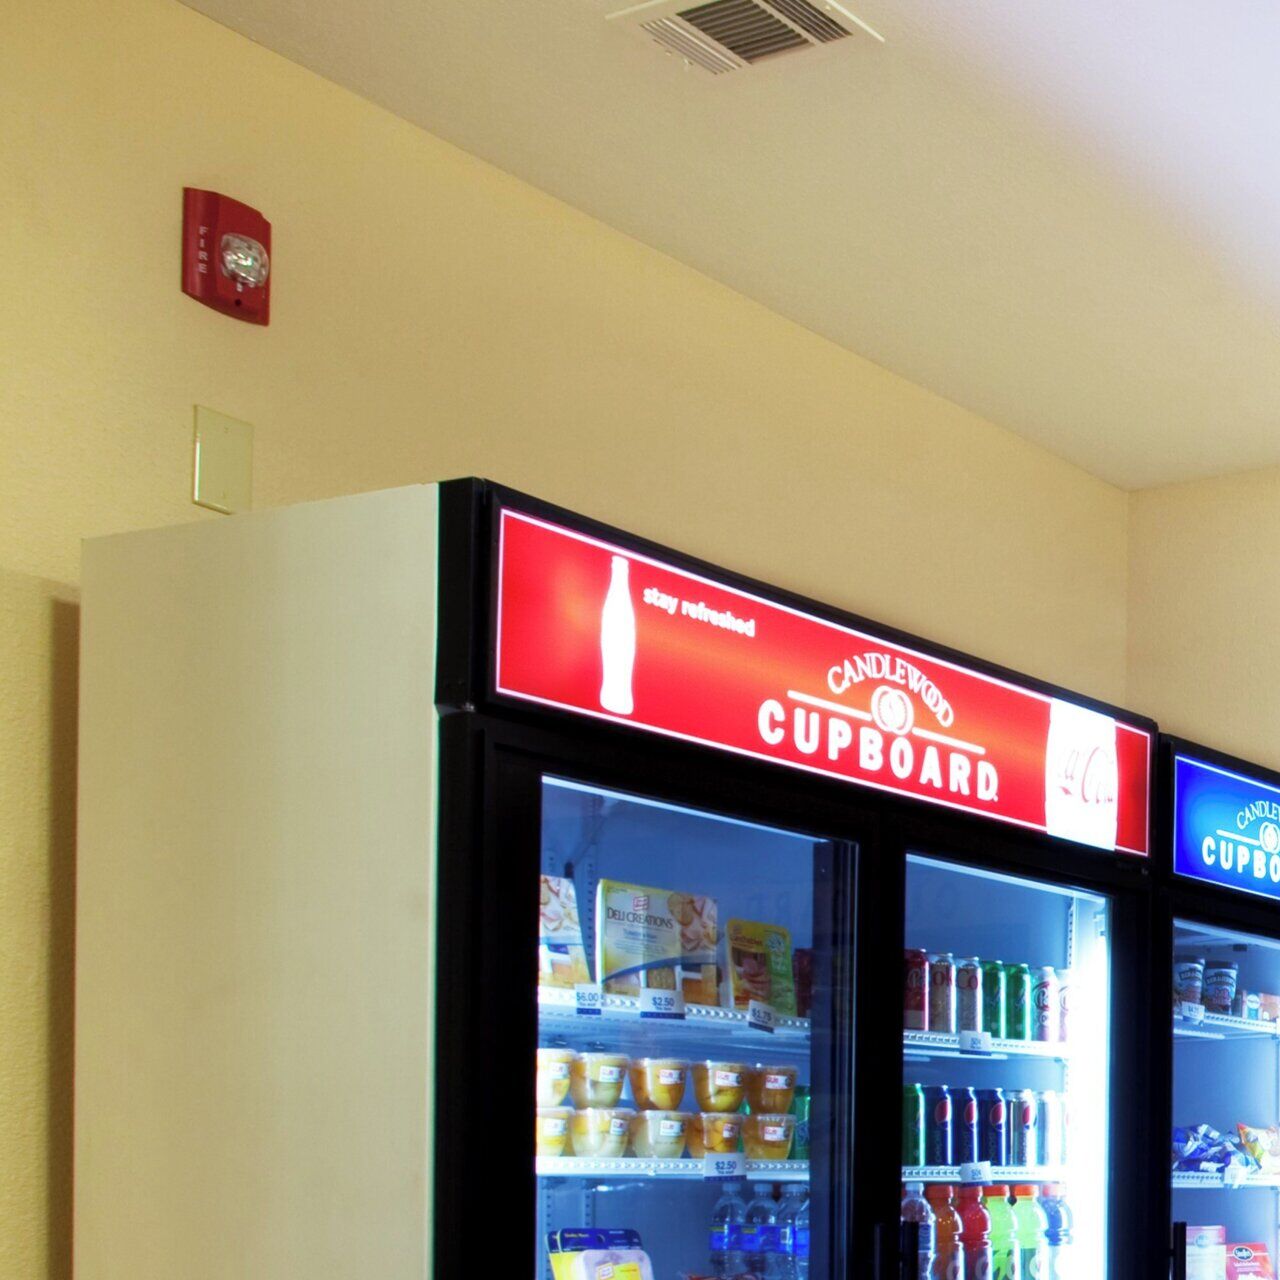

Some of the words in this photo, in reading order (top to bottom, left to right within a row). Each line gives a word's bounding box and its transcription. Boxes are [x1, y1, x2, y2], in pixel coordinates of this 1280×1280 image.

[643, 587, 679, 616] stay
[681, 600, 756, 638] refreshed
[827, 652, 955, 728] CANDLEWOOD
[757, 698, 998, 802] CUPBOARD
[607, 906, 626, 921] DELI
[626, 910, 674, 930] CREATIONS
[576, 991, 599, 1002] $6.00
[714, 1160, 737, 1171] $2.50
